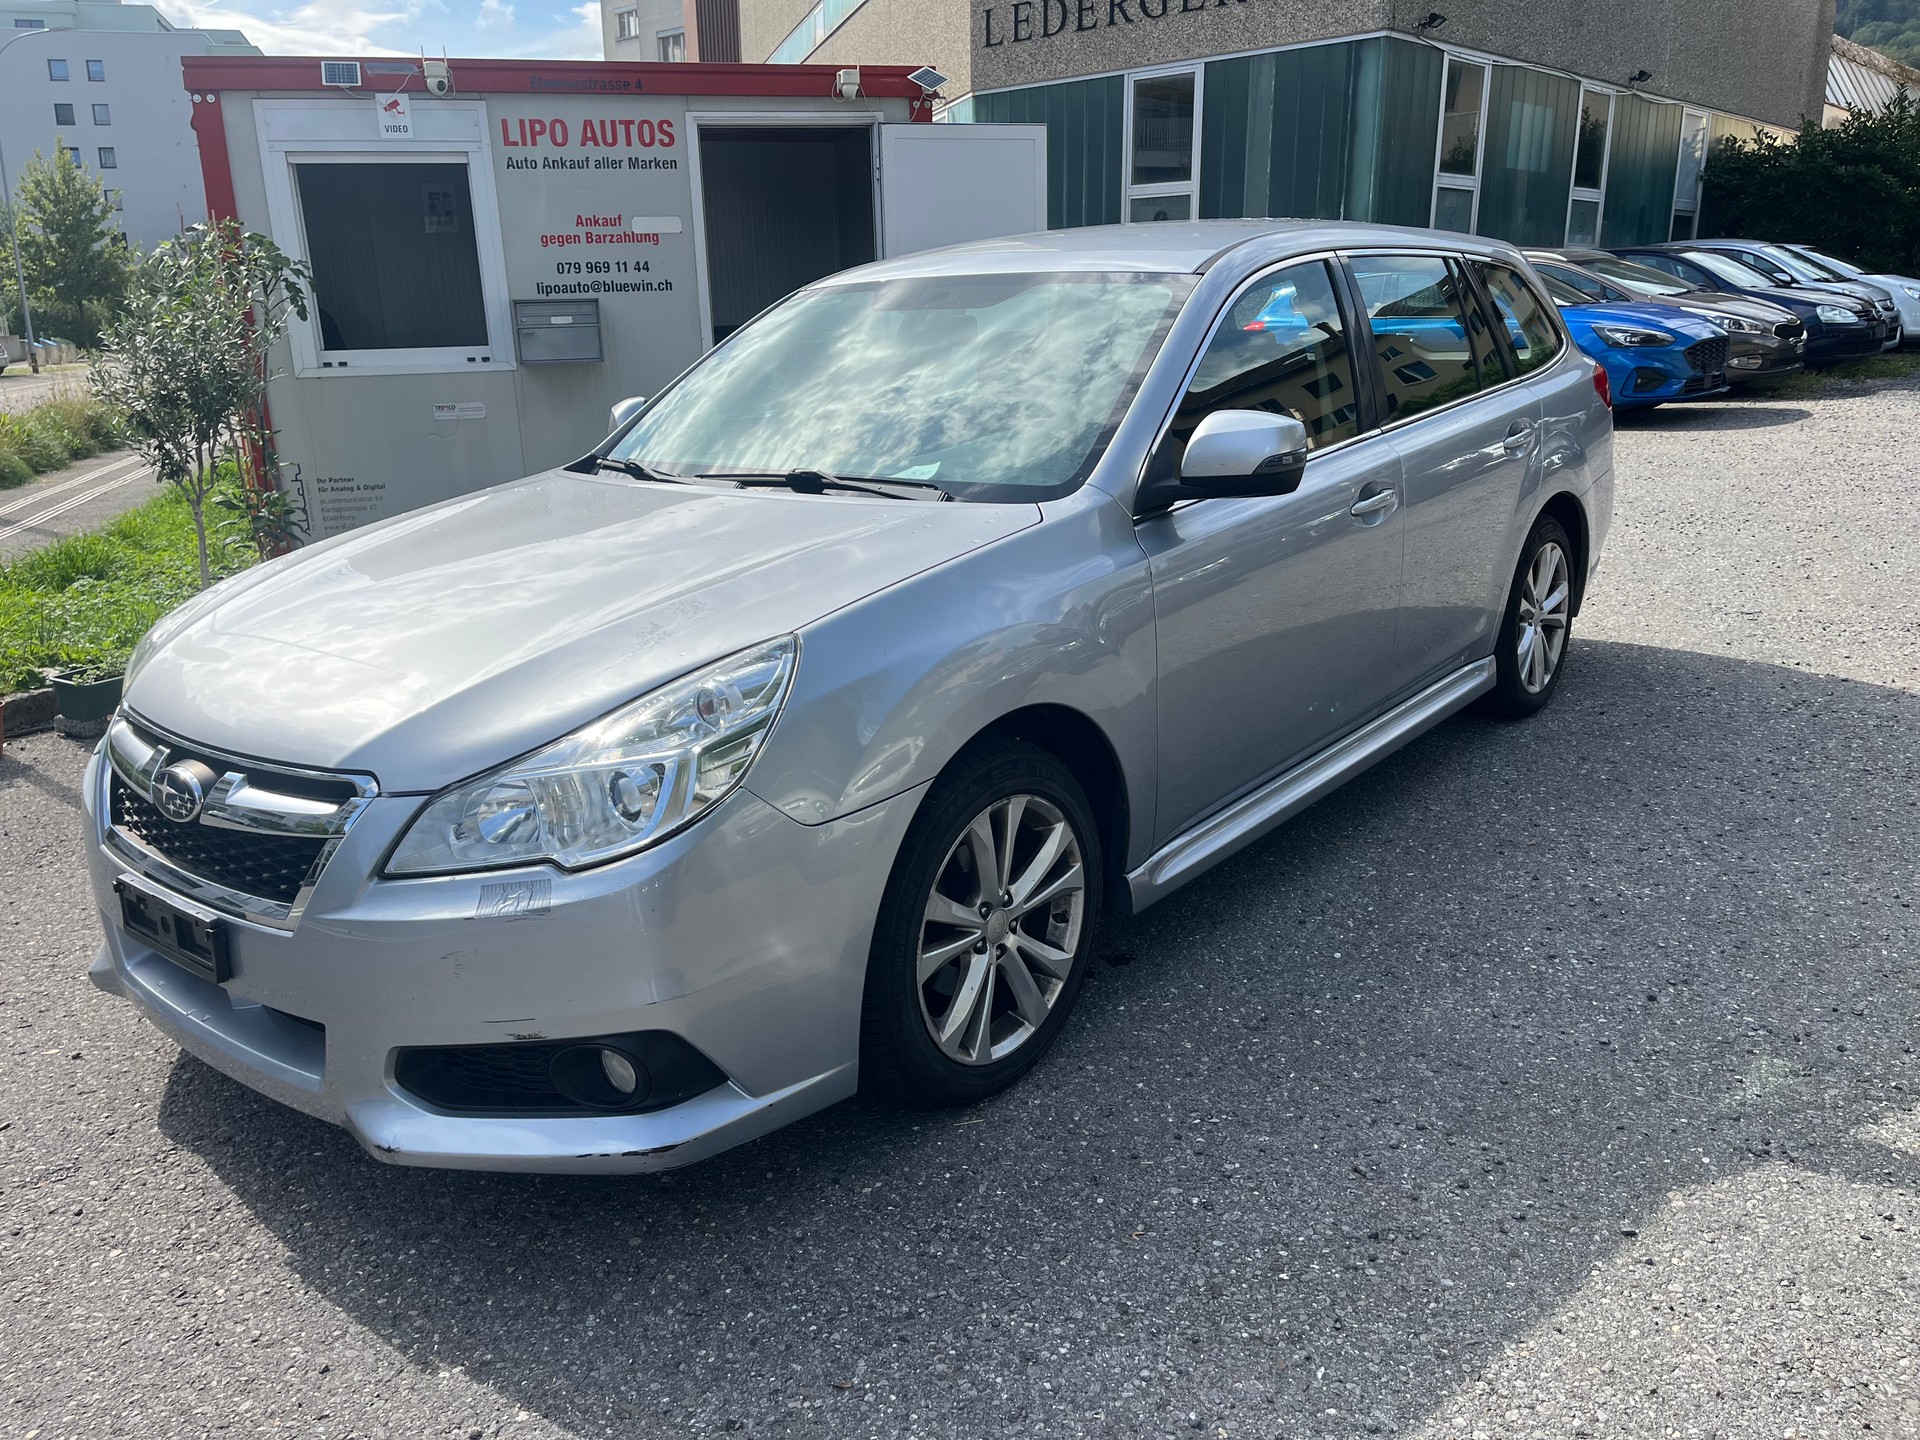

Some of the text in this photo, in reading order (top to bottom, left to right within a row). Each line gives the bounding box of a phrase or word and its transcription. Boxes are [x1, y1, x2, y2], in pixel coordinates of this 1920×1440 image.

[983, 0, 1248, 48] LEDERG
[634, 79, 643, 91] 4
[384, 125, 409, 133] VIDEO
[501, 118, 675, 148] LIPO AUTOS
[506, 156, 678, 170] Auto Ankauf aller Marken
[575, 214, 622, 228] Ankauf
[540, 231, 660, 247] gegen Barzahlung
[556, 260, 650, 275] 079 969 11 44
[536, 279, 673, 297] lipoauto@bluewin.ch
[330, 485, 355, 493] Analog
[363, 484, 386, 492] Digital
